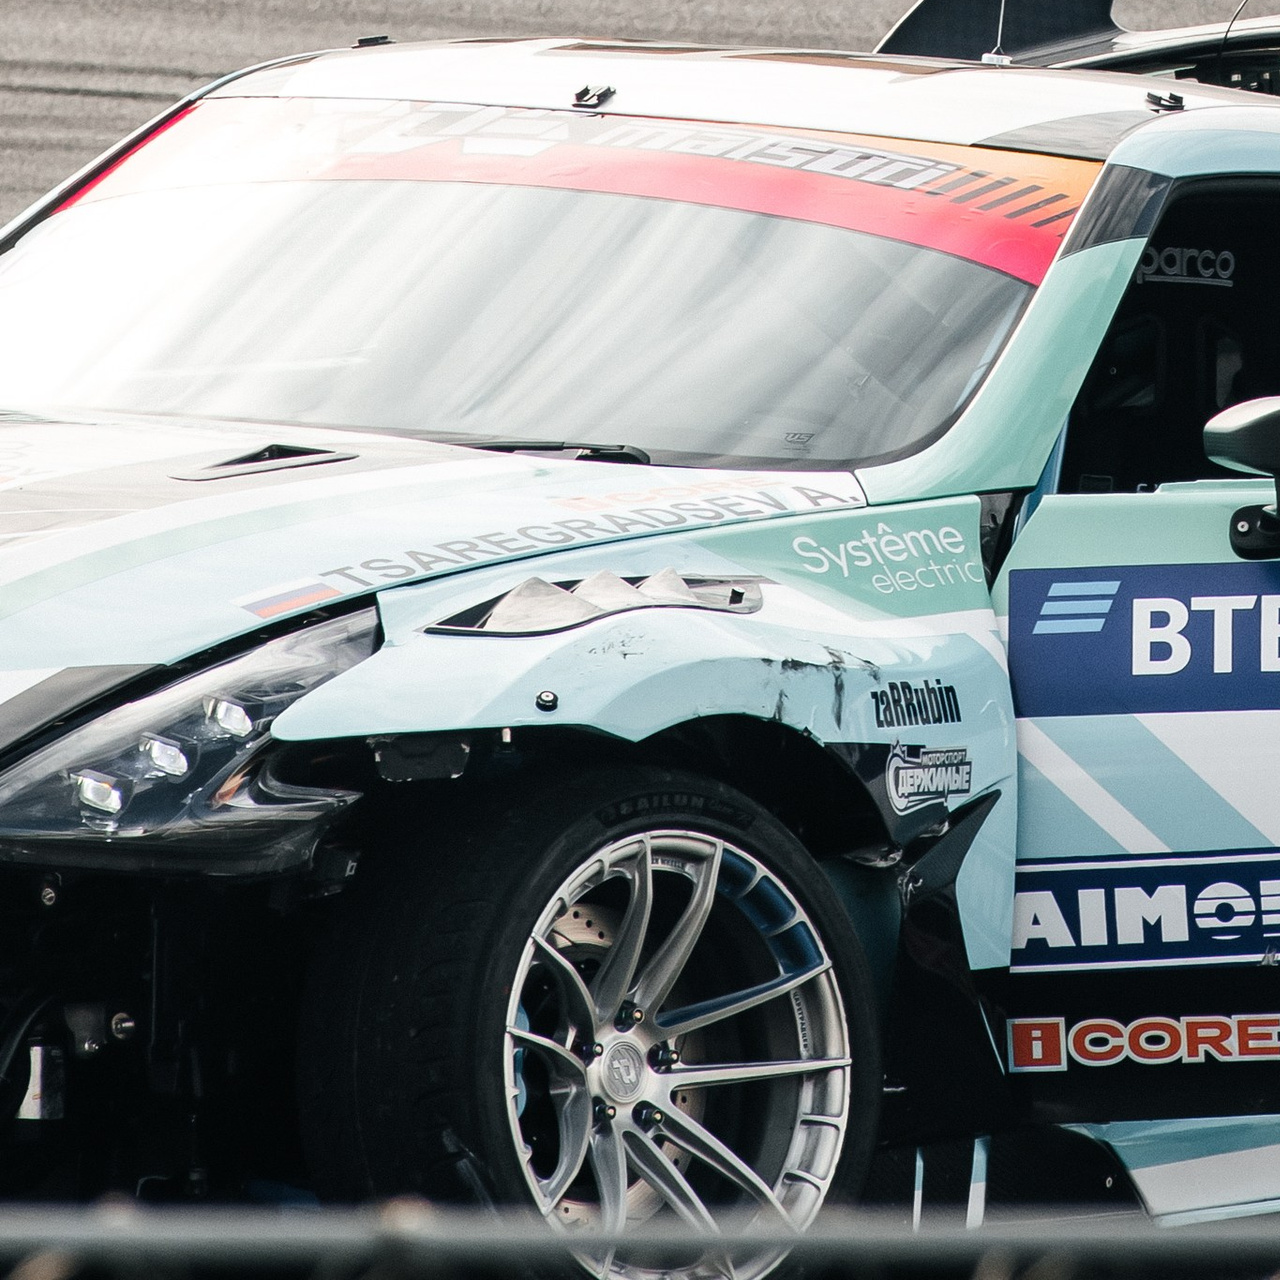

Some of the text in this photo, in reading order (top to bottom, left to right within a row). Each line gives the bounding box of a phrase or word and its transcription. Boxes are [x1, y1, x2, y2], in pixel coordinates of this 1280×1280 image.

[1137, 246, 1236, 284] parco
[319, 490, 790, 582] TSAREGRADSEV
[792, 522, 965, 577] Système
[872, 558, 983, 594] electric
[870, 678, 962, 728] zaRRubin
